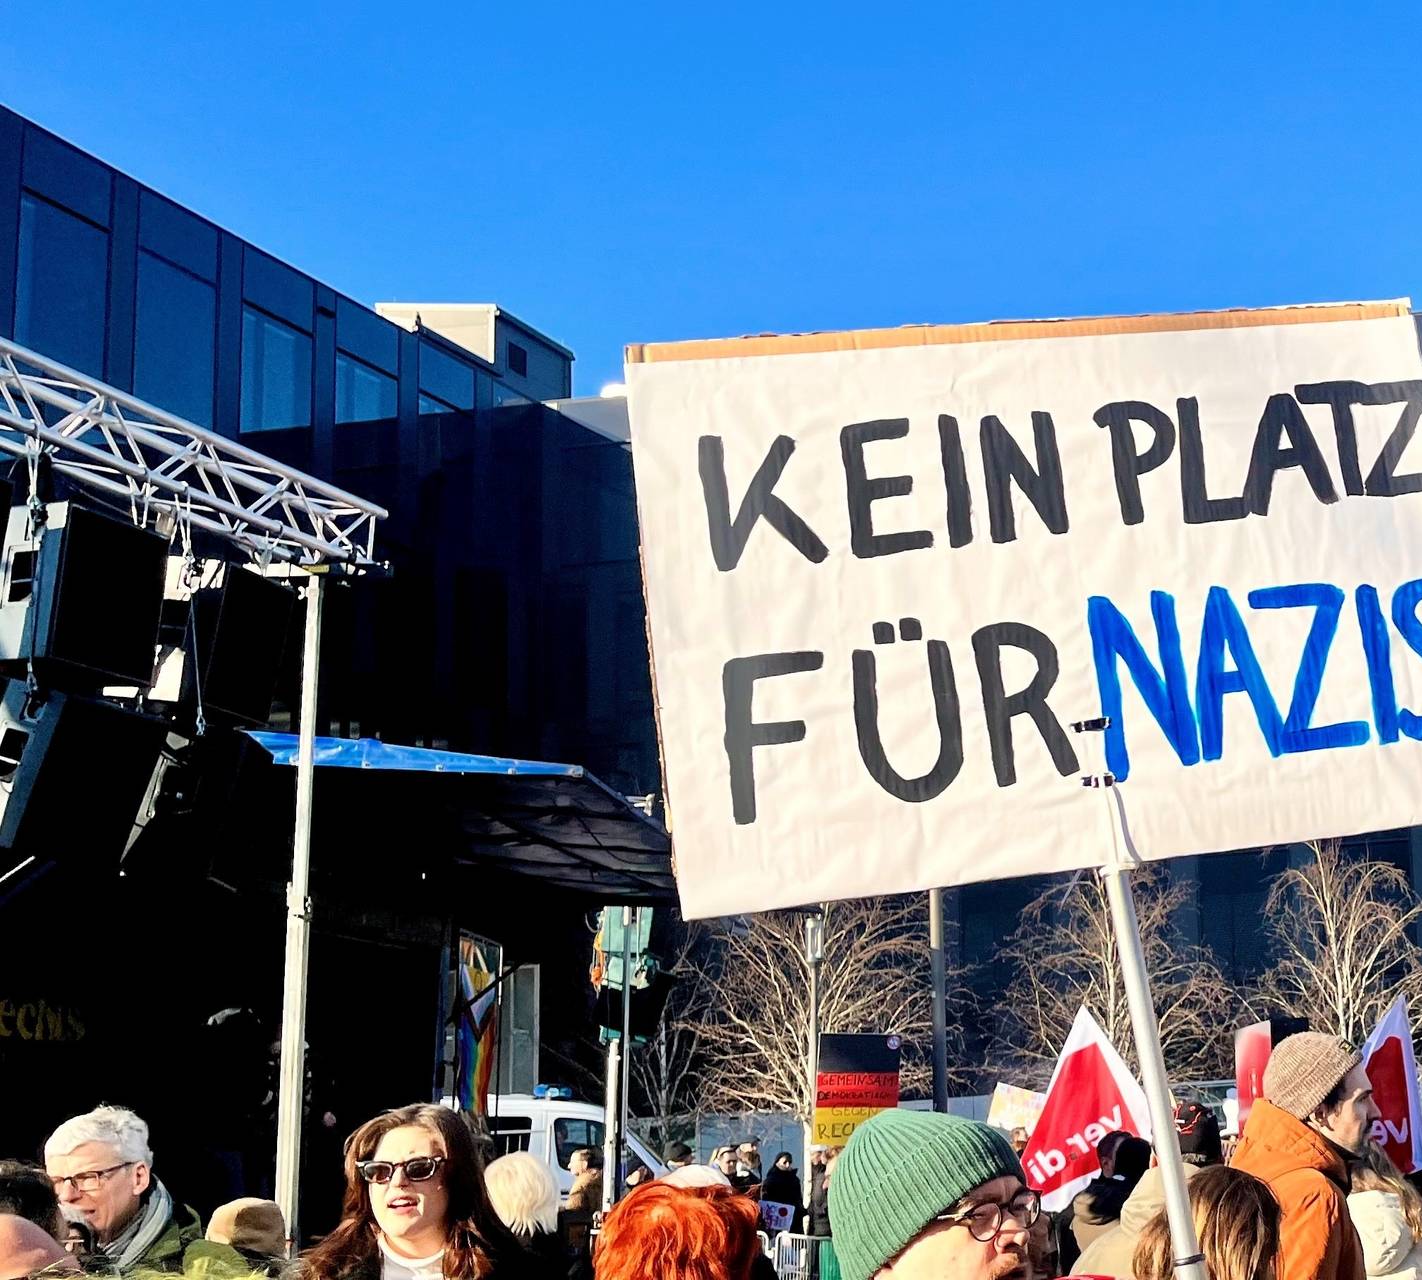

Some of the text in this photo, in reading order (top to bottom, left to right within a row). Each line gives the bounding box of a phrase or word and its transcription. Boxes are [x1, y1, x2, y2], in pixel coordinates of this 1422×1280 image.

[698, 410, 1070, 572] KEIN
[721, 616, 1081, 824] FÜR
[817, 1122, 856, 1139] REC
